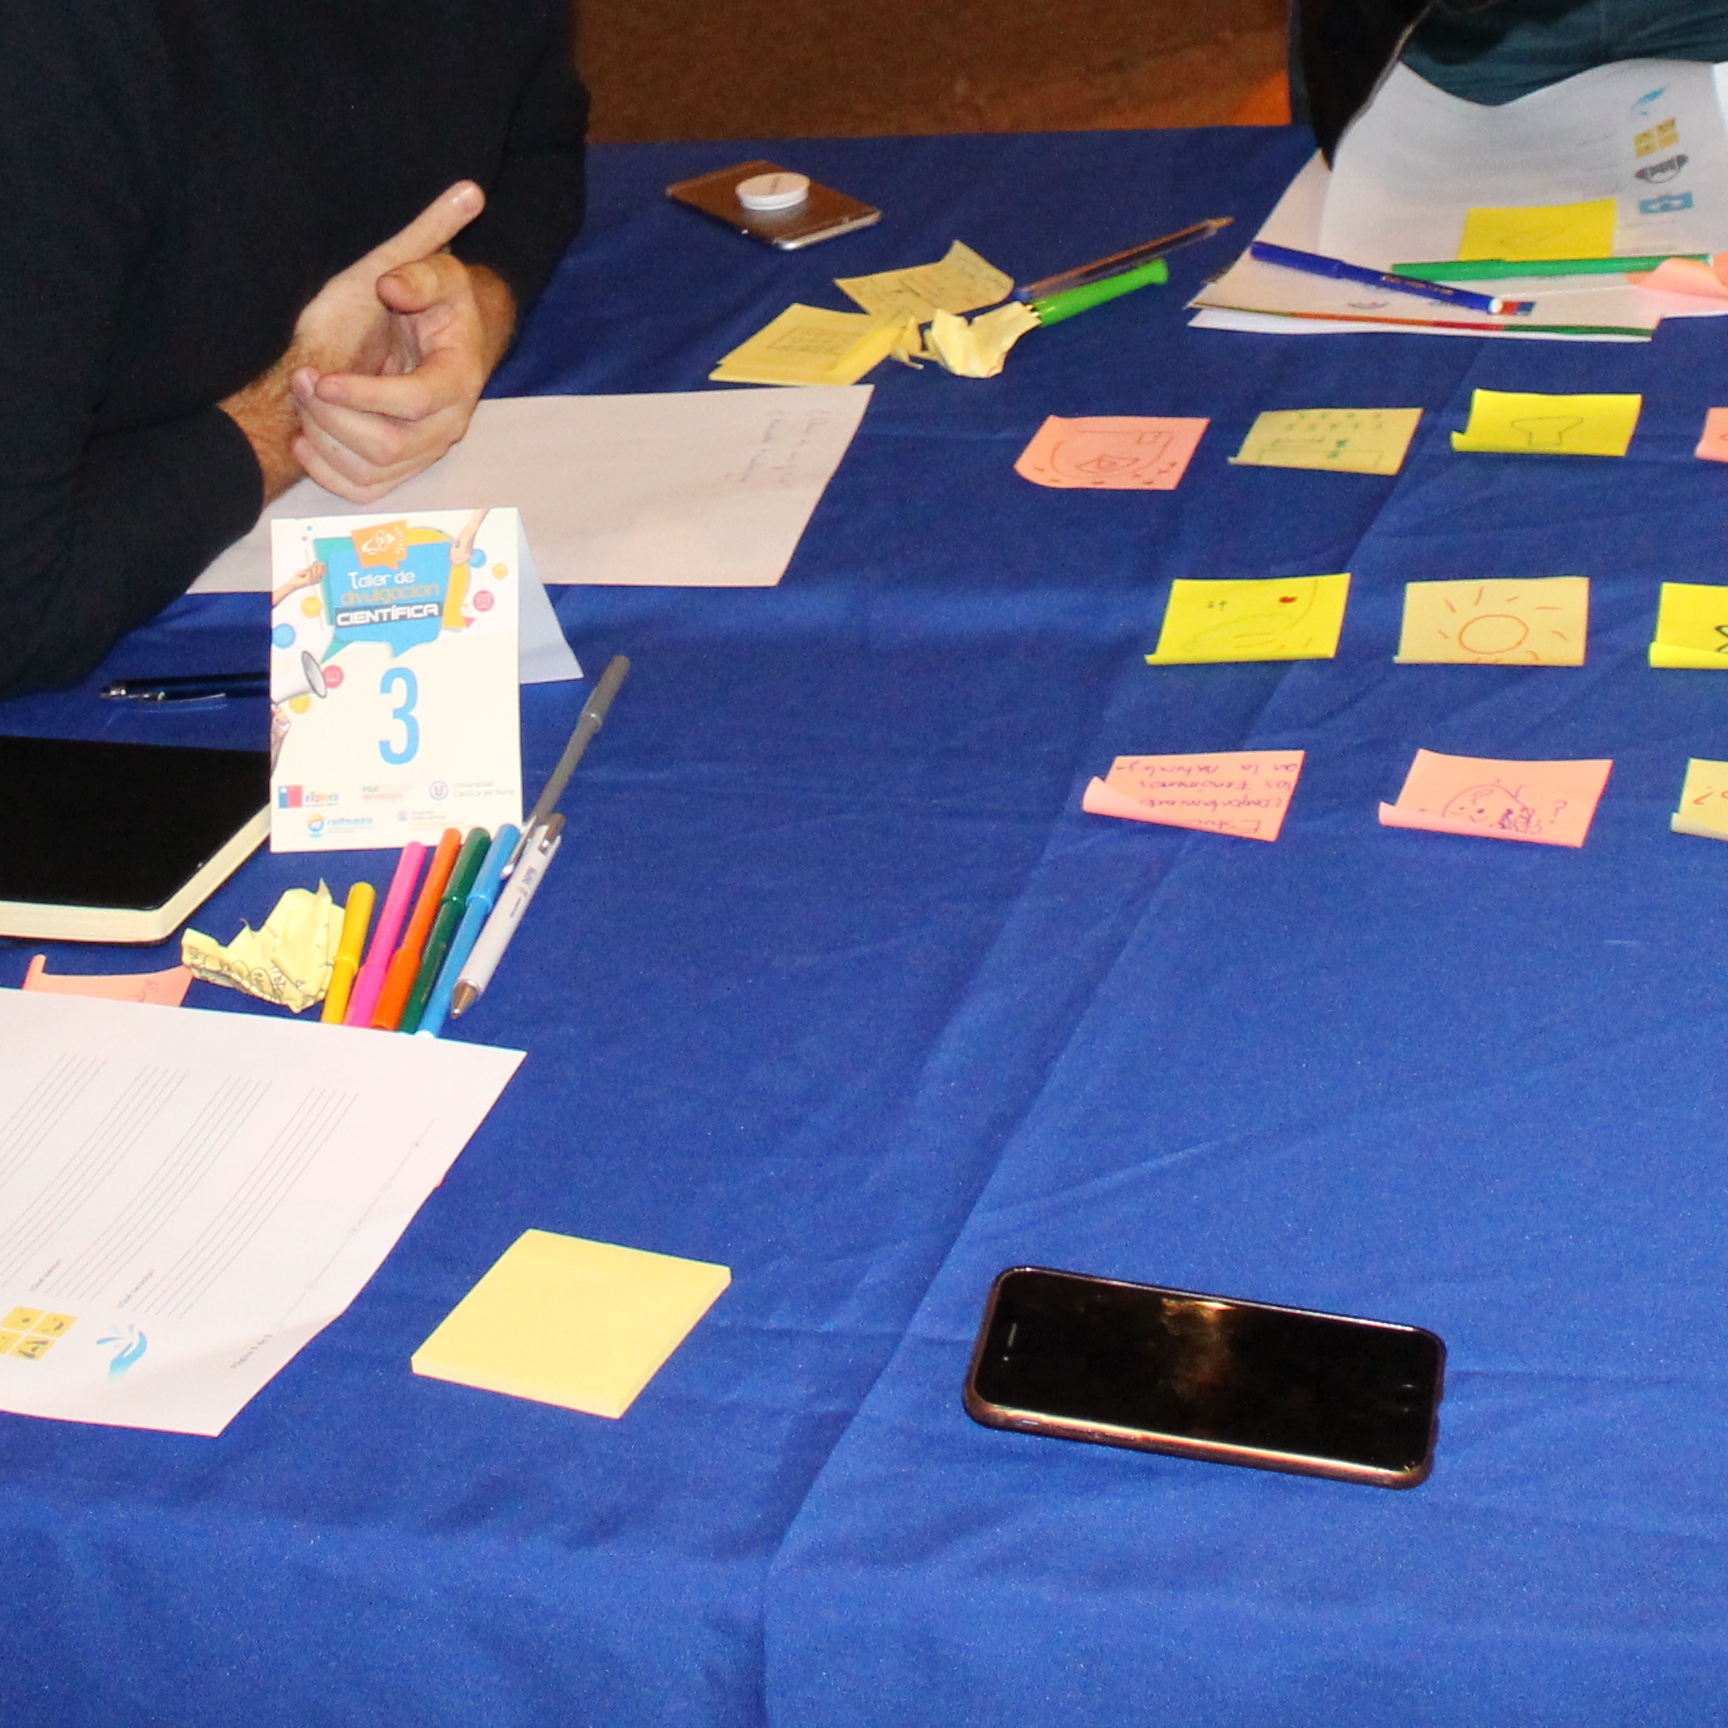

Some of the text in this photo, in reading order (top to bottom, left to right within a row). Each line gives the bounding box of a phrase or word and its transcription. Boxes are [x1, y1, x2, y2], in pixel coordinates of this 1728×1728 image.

[347, 570, 416, 590] Taller de
[336, 604, 439, 627] CIENTÍFICA
[378, 666, 420, 766] 3
